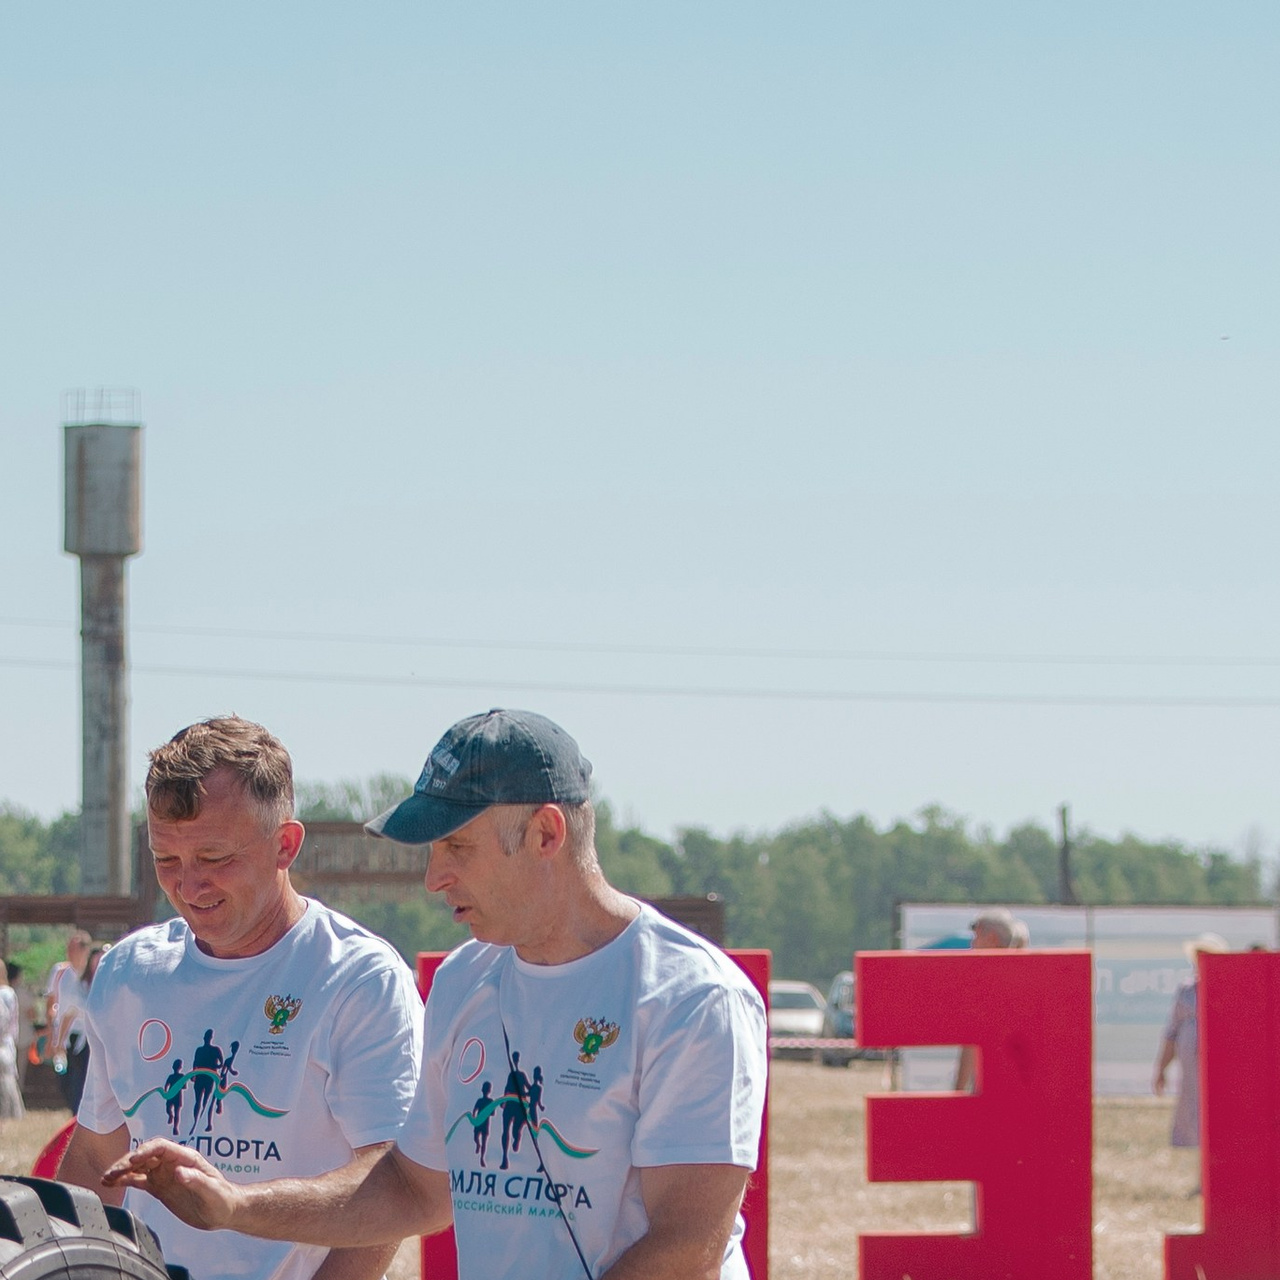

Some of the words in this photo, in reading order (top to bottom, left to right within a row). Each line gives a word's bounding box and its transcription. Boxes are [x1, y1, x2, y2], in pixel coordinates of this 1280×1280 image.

[213, 1162, 261, 1174] АРАФОН
[449, 1169, 496, 1197] МЛЯ
[528, 1206, 576, 1222] МАРАО
